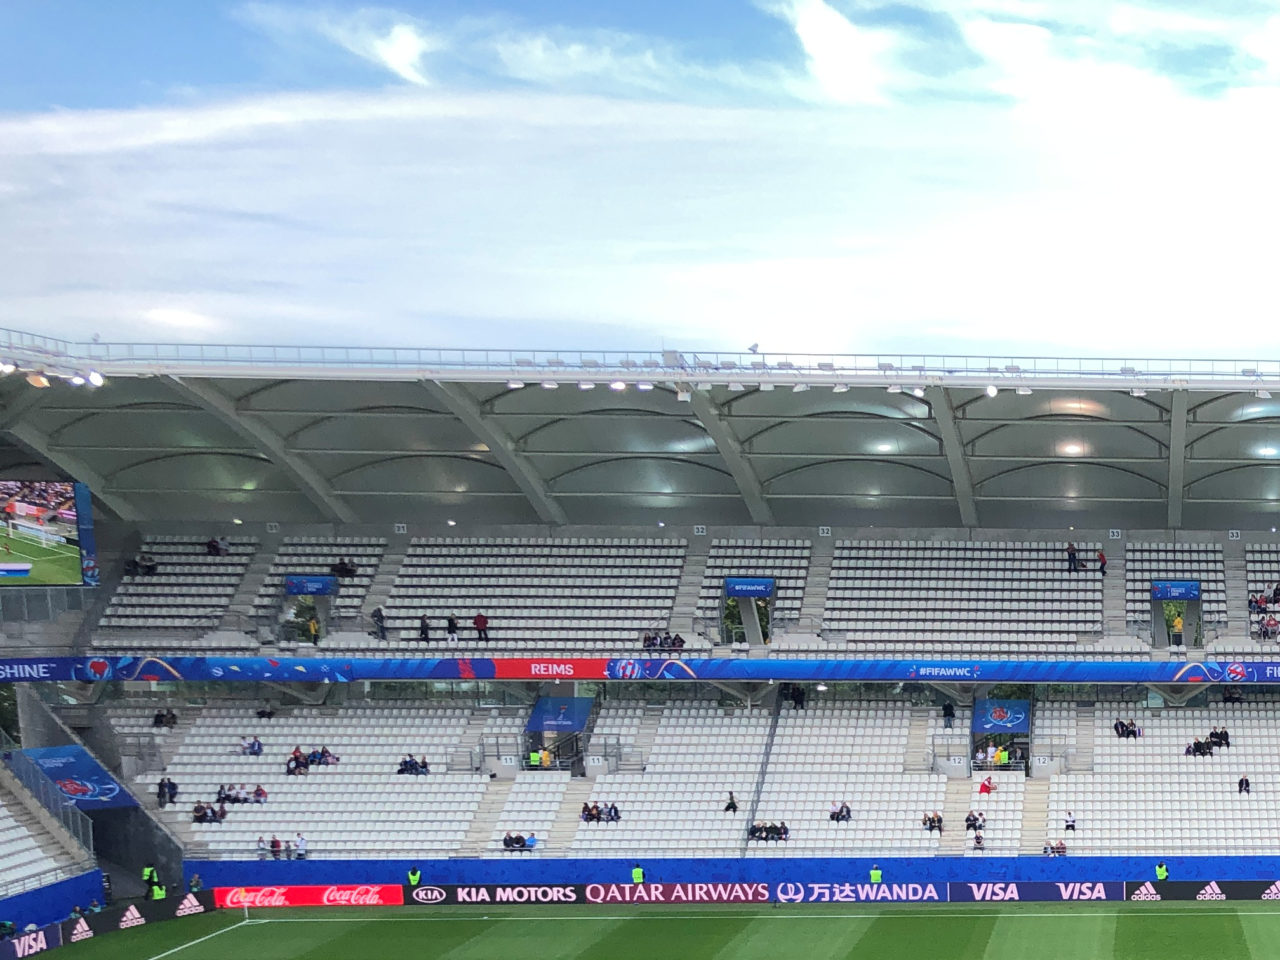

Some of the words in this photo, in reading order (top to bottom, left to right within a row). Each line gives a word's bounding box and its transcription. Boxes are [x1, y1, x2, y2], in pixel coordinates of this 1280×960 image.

[531, 664, 574, 675] REIMS
[919, 667, 971, 676] #FIFAWWC
[323, 886, 382, 904] Coca-Cola
[418, 890, 440, 899] KIA
[457, 887, 490, 902] KIA
[496, 887, 577, 902] MOTORS
[585, 883, 665, 903] QATAR
[671, 883, 769, 901] AIRWAYS
[968, 883, 1019, 900] VISA
[1055, 883, 1106, 900] VISA
[11, 931, 47, 958] VISA
